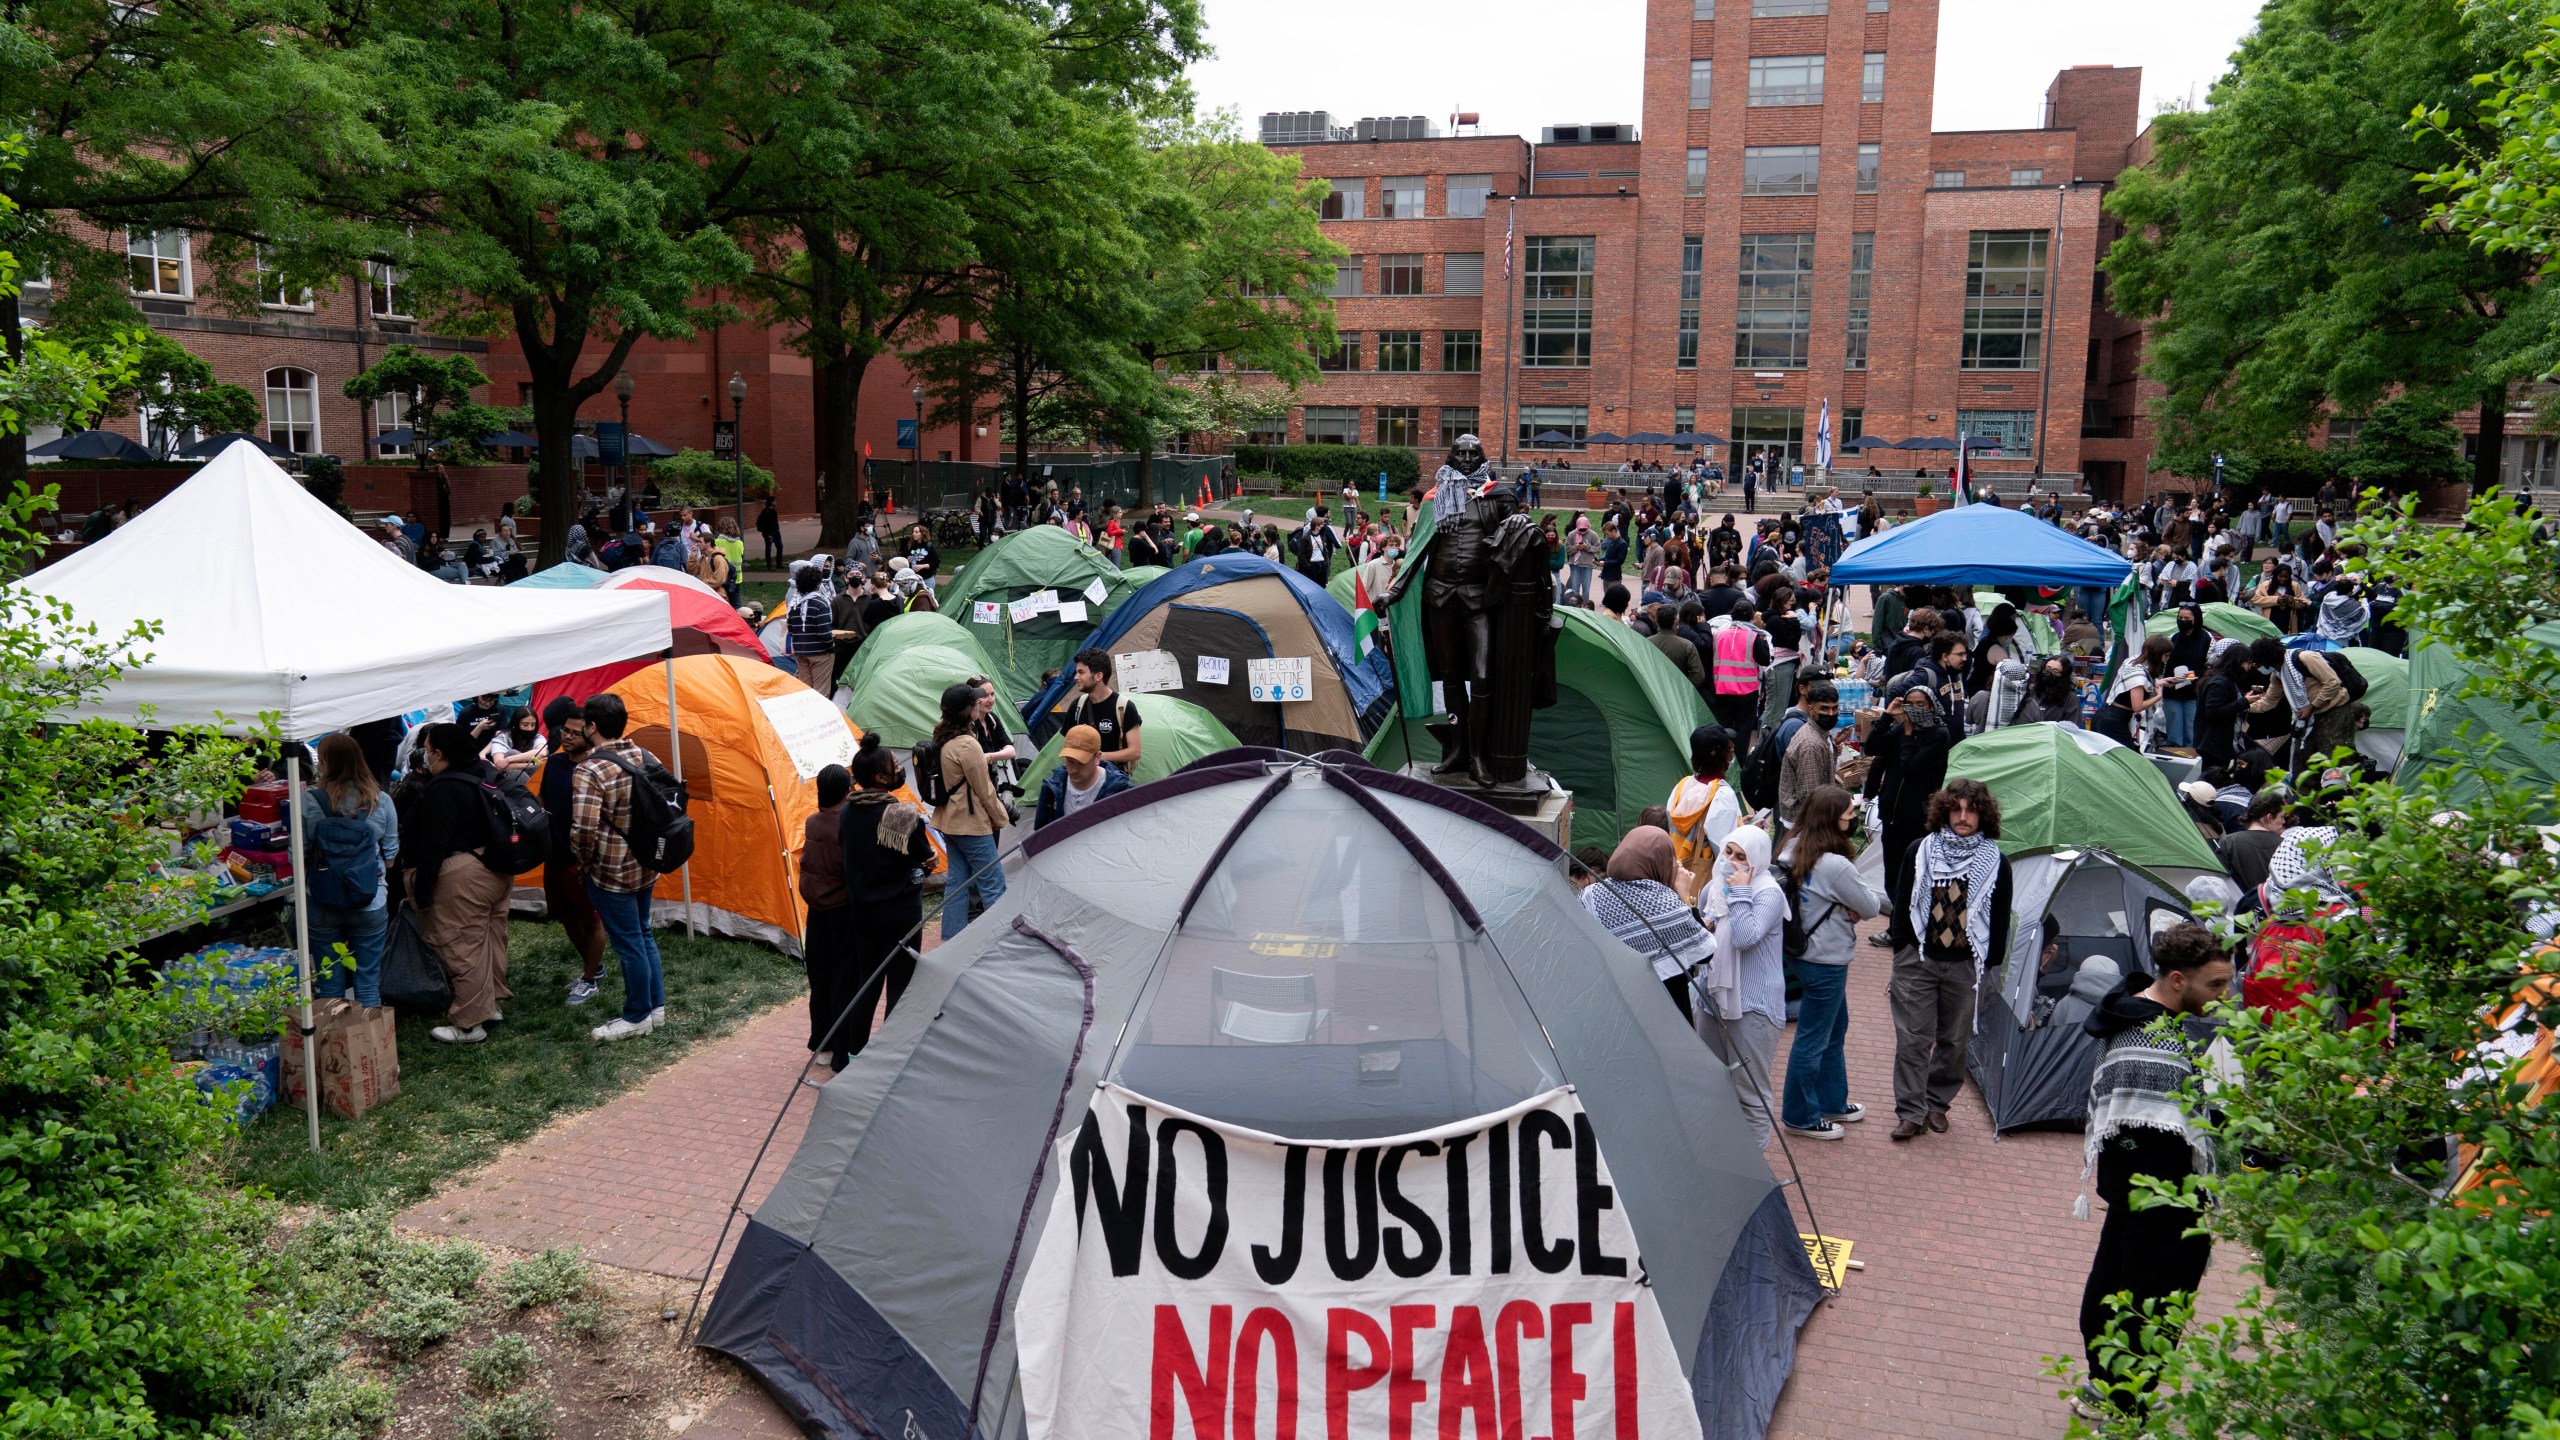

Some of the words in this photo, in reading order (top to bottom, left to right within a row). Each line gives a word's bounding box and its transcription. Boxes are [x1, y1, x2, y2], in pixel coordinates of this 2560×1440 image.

[716, 434, 733, 448] REVS
[976, 603, 983, 612] I
[1249, 659, 1265, 671] ALL
[1269, 659, 1288, 671] EYES
[1292, 659, 1303, 670] ON
[1255, 671, 1304, 686] PALESTINE
[360, 1055, 368, 1076] JOE'S
[363, 1078, 372, 1107] TRADER
[1070, 1104, 1229, 1280] NO
[1150, 1304, 1299, 1440] NO
